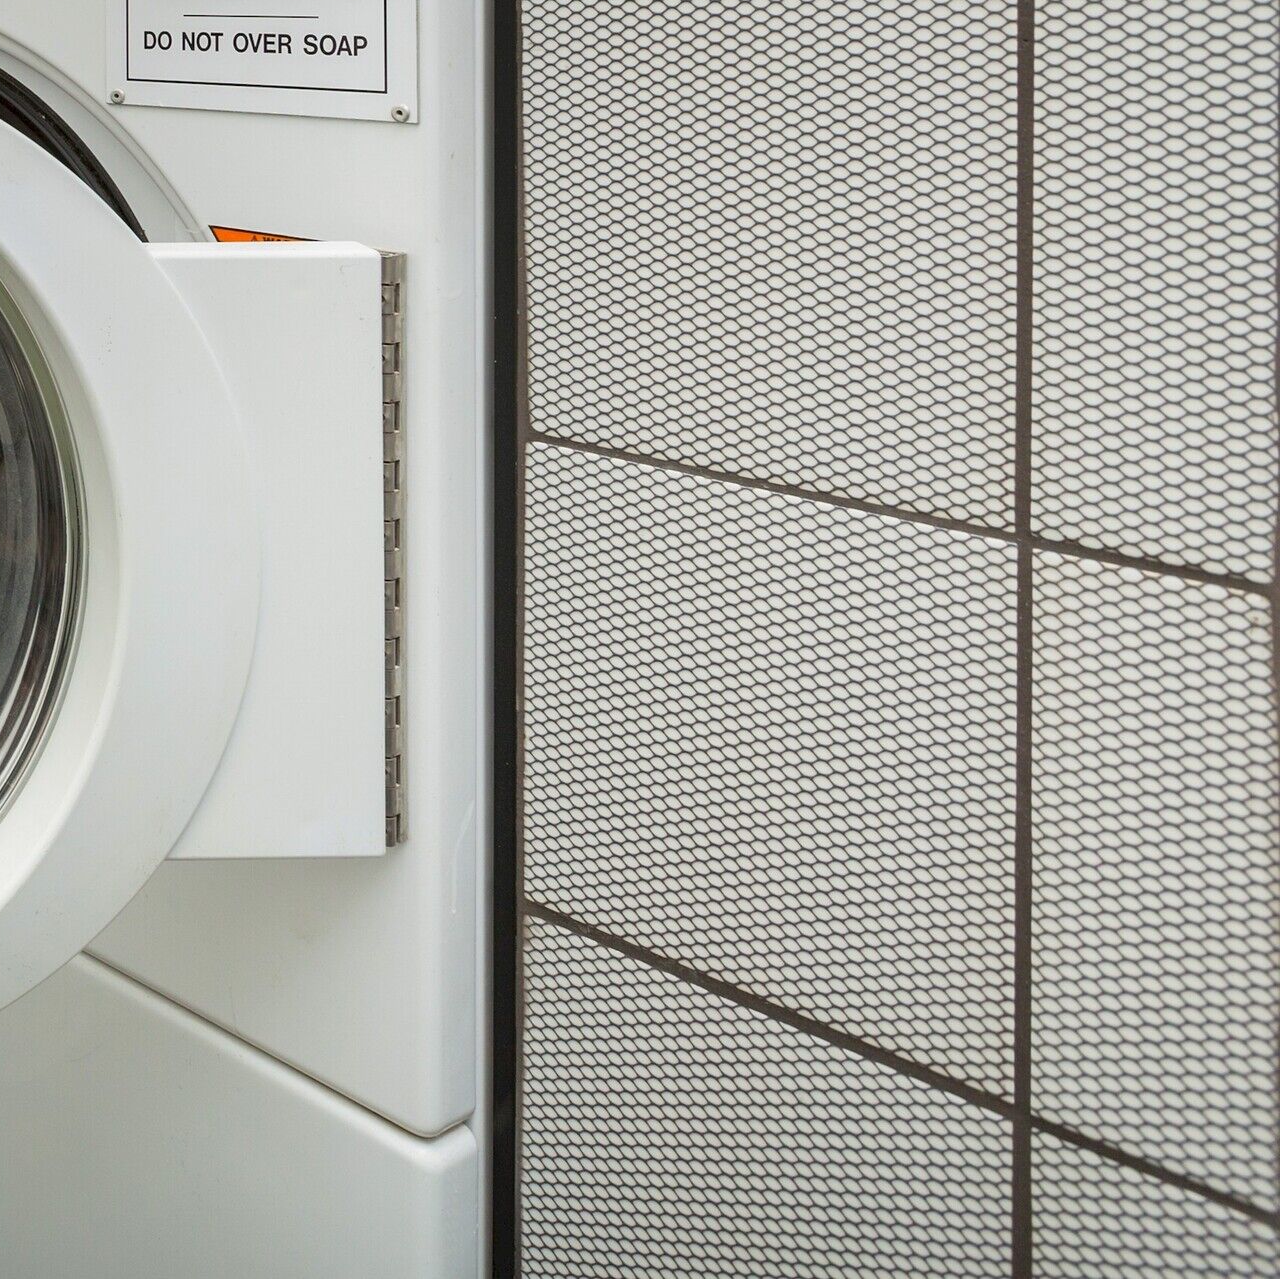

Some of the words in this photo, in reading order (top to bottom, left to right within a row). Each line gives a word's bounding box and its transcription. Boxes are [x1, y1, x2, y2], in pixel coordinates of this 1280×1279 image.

[143, 31, 172, 50] DO
[181, 31, 223, 52] NOT
[232, 33, 292, 54] OVER
[303, 34, 368, 57] SOAP
